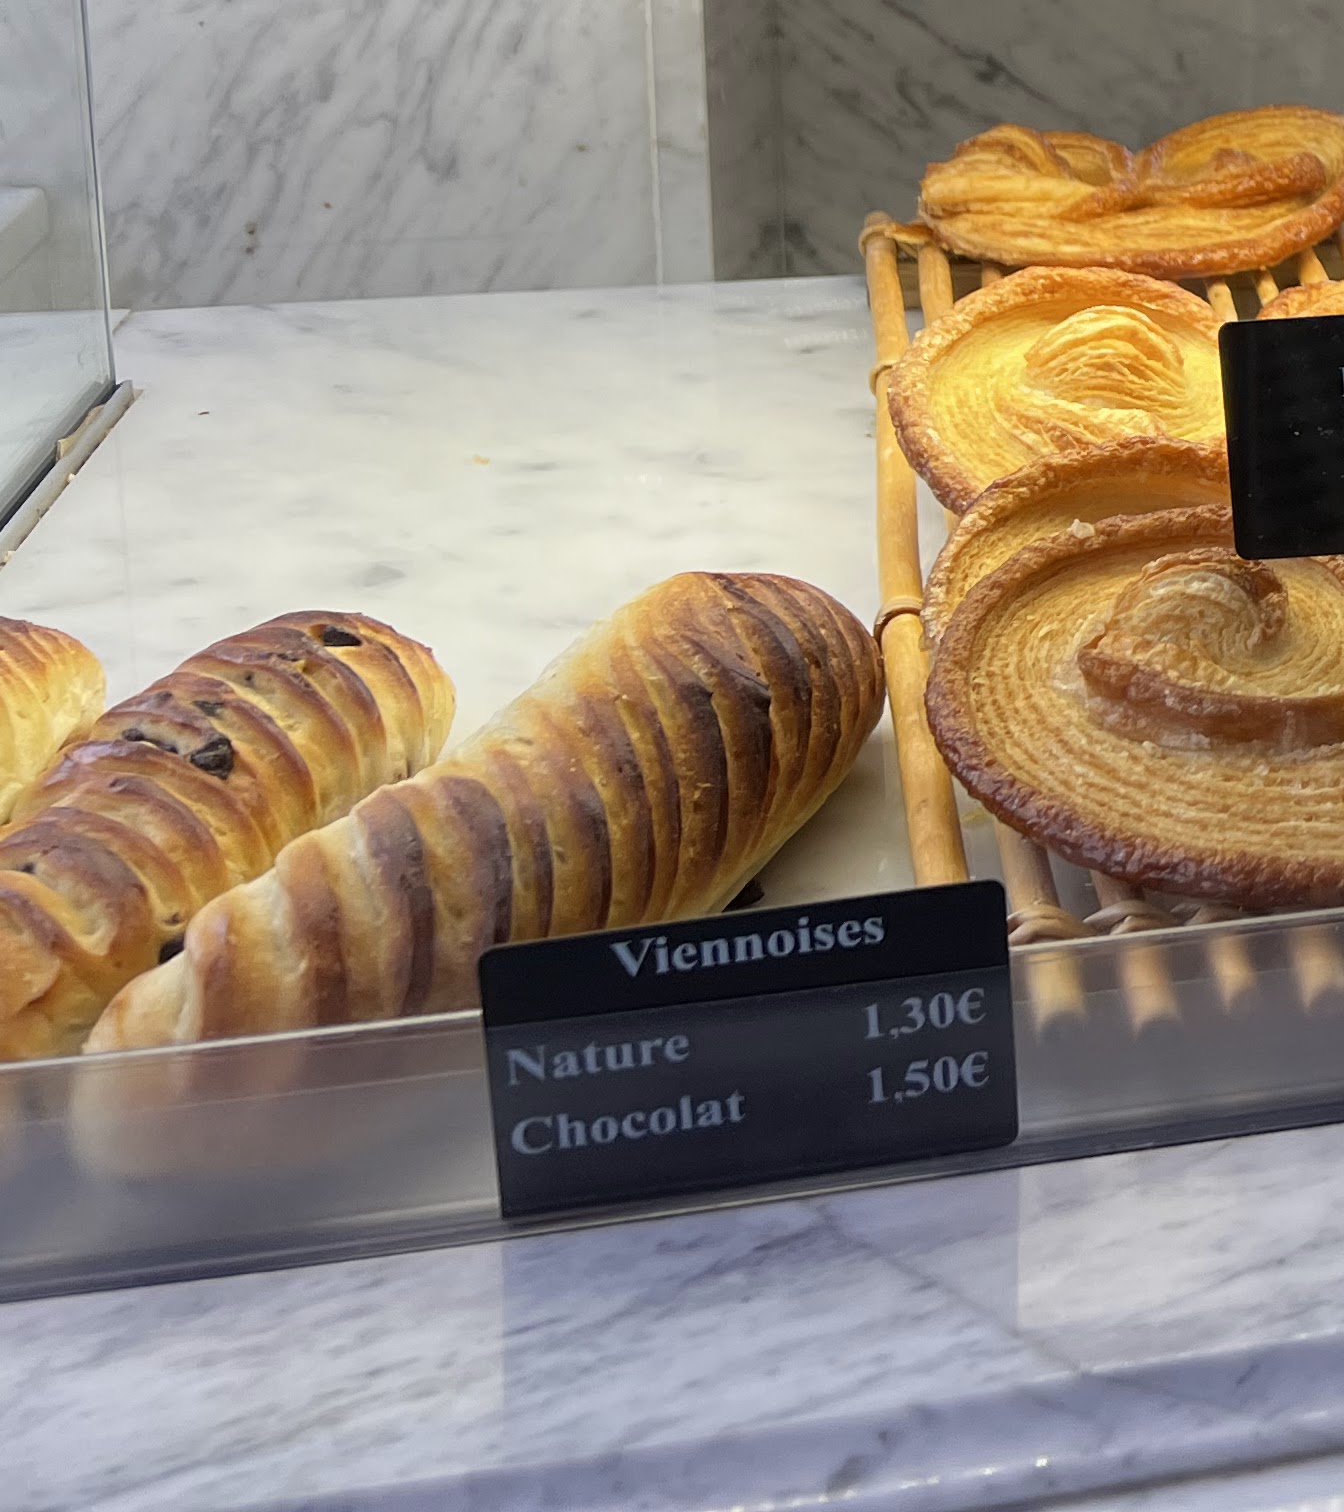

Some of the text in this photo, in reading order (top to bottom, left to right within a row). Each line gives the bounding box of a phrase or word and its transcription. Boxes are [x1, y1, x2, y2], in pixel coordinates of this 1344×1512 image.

[610, 915, 885, 978] Viennoises
[507, 988, 987, 1086] Nature 1,30€
[512, 1051, 990, 1156] Chocolat 1,50€
